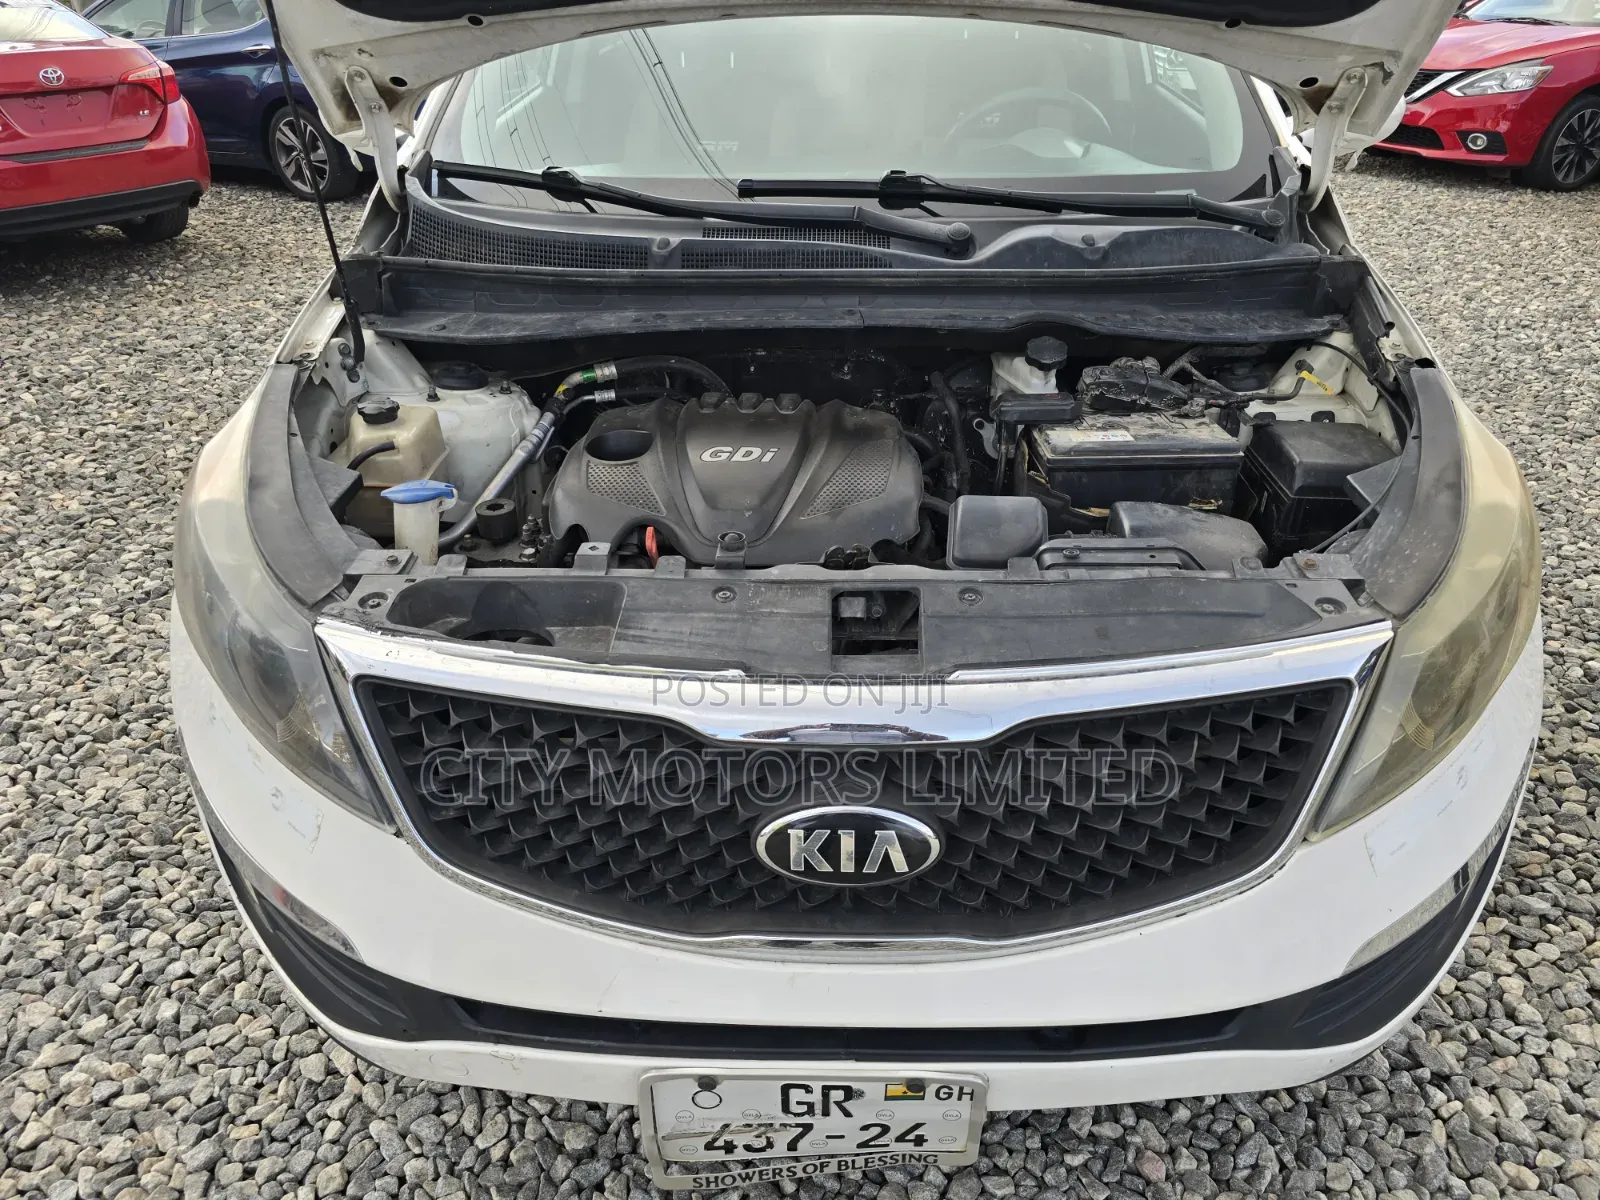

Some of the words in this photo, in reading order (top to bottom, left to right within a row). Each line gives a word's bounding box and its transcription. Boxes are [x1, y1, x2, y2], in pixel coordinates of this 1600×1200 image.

[700, 446, 780, 463] GDi
[787, 829, 910, 873] KIA
[780, 1082, 854, 1118] GR
[934, 1084, 975, 1102] GH
[703, 1122, 929, 1155] 437-24
[692, 1164, 798, 1190] SHOWERS
[802, 1161, 832, 1176] OF
[837, 1152, 939, 1173] BLESSING
